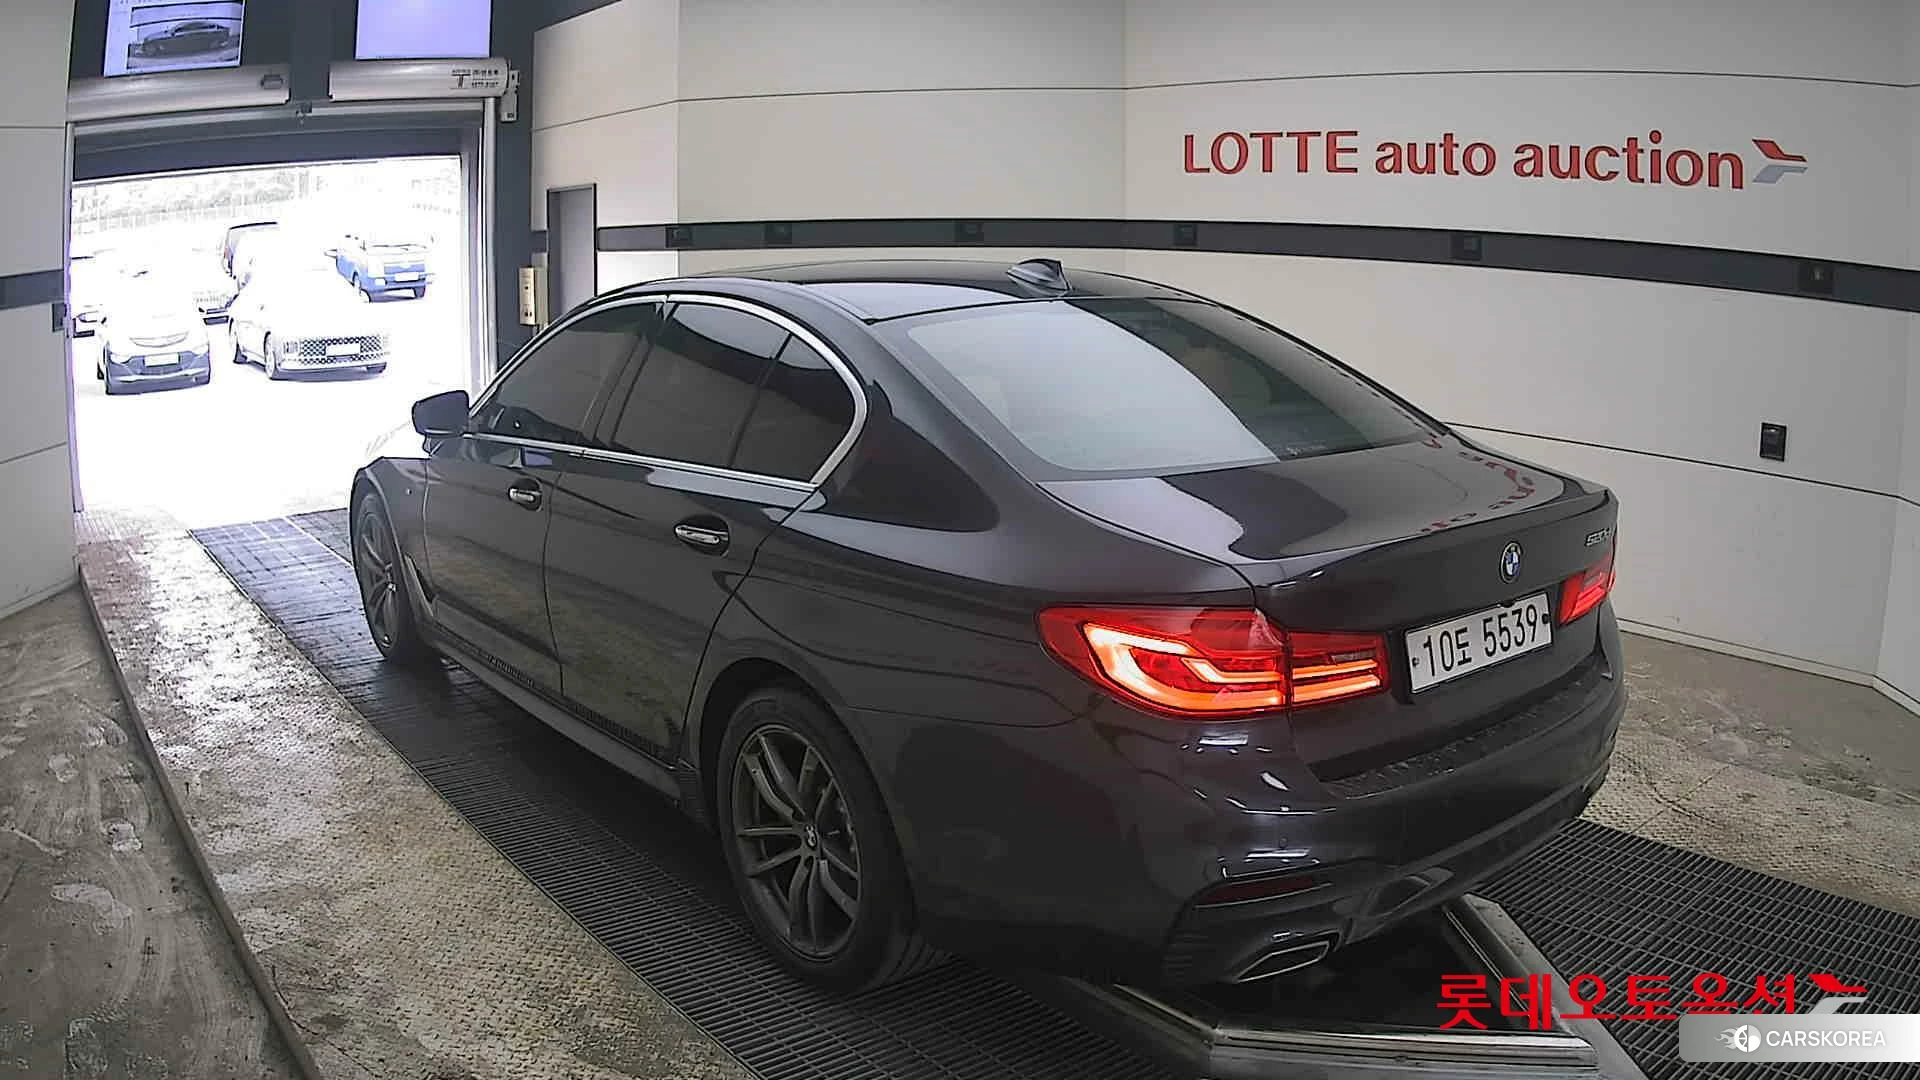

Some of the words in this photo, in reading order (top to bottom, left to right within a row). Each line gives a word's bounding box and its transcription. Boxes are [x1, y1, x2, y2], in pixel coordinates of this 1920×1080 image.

[1184, 130, 1358, 175] LOTTE
[1375, 132, 1497, 176] auto
[1513, 129, 1745, 190] auction
[1423, 626, 1472, 677] 10도
[1482, 604, 1538, 658] 5539
